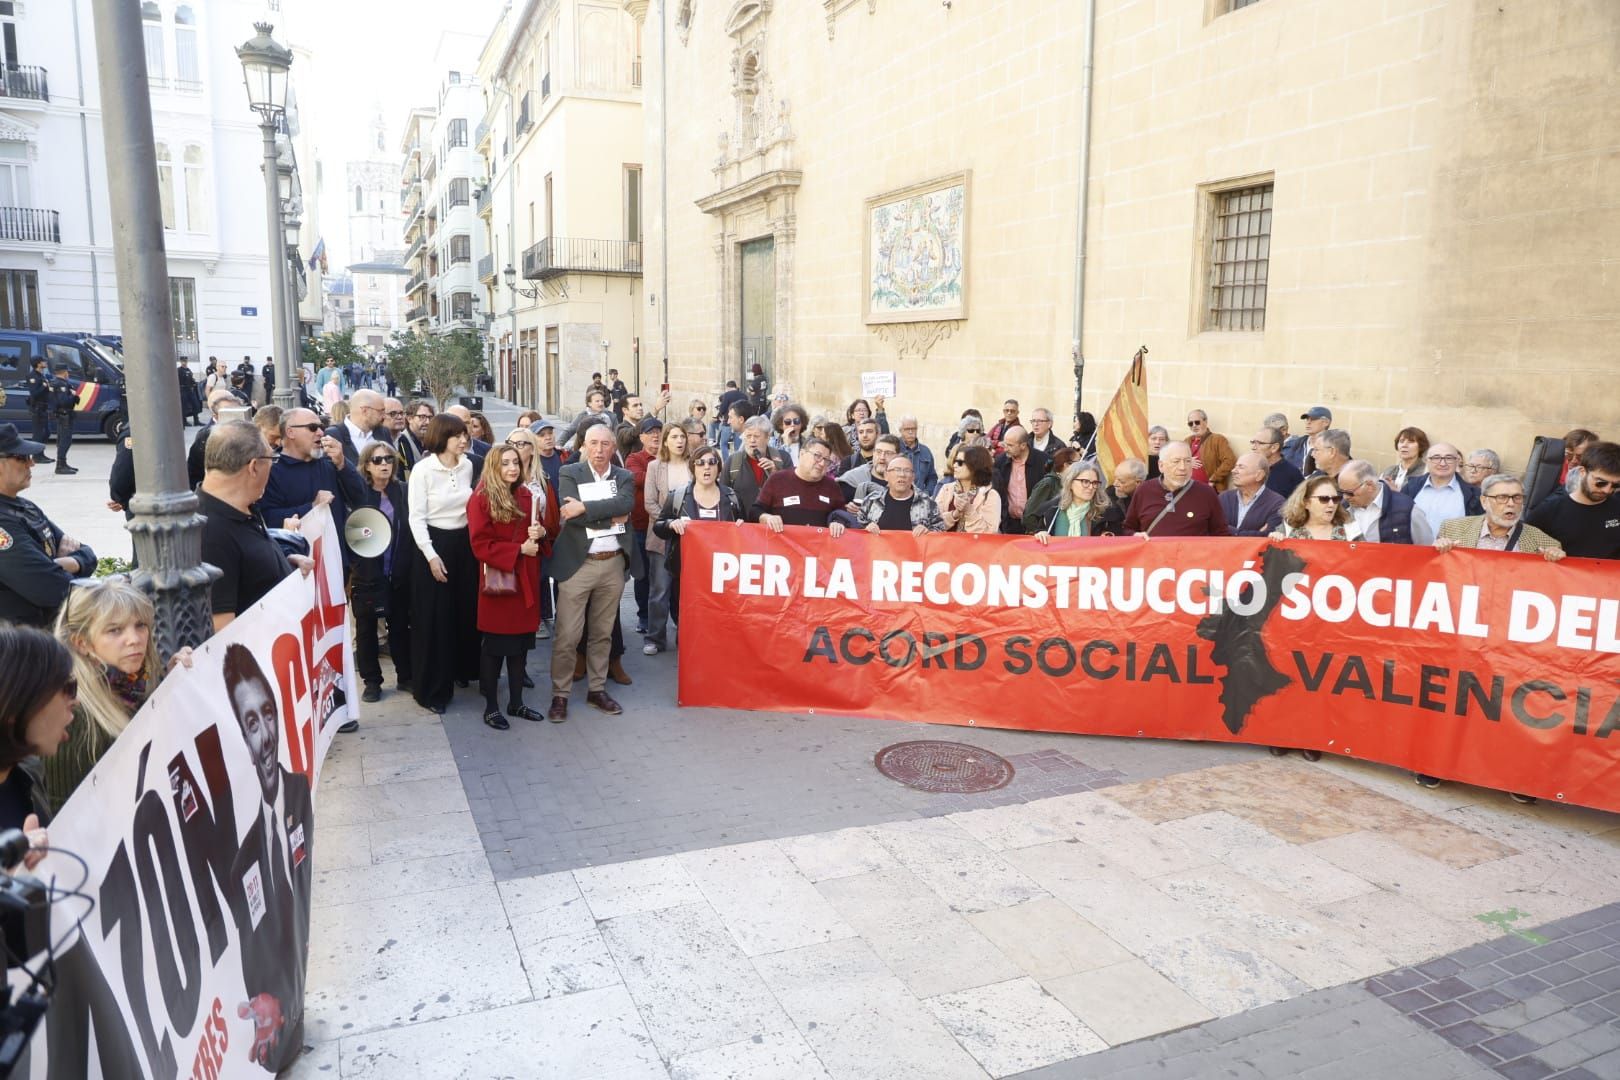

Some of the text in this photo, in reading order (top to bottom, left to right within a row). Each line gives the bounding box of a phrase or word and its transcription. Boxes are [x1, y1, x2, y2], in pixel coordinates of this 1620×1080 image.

[711, 552, 791, 598] PER
[803, 558, 859, 600] LA
[871, 560, 1268, 617] RECONSTRUCCIÓ
[1280, 572, 1489, 638] SOCIAL
[802, 625, 988, 671] ACORD
[1003, 635, 1215, 684] SOCIAL
